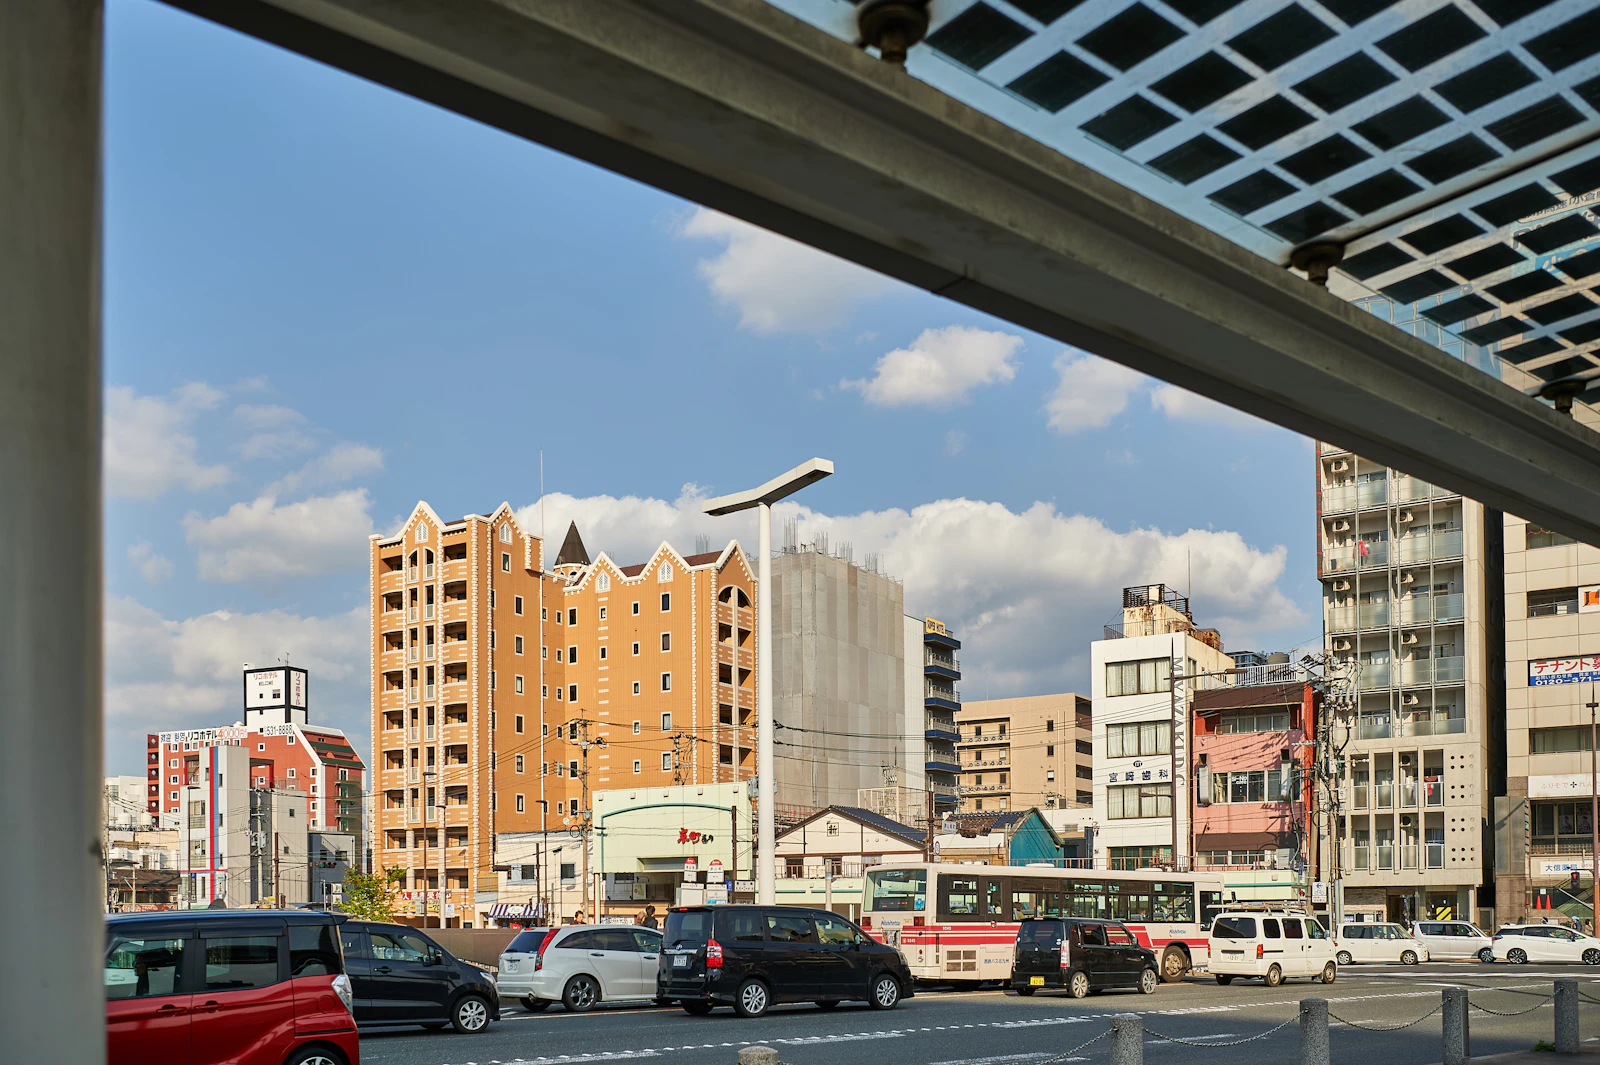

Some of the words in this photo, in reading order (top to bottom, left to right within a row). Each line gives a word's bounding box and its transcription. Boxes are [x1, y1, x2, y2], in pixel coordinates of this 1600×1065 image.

[1173, 656, 1184, 750] MIYAZAKI
[187, 730, 217, 740] リコホテル
